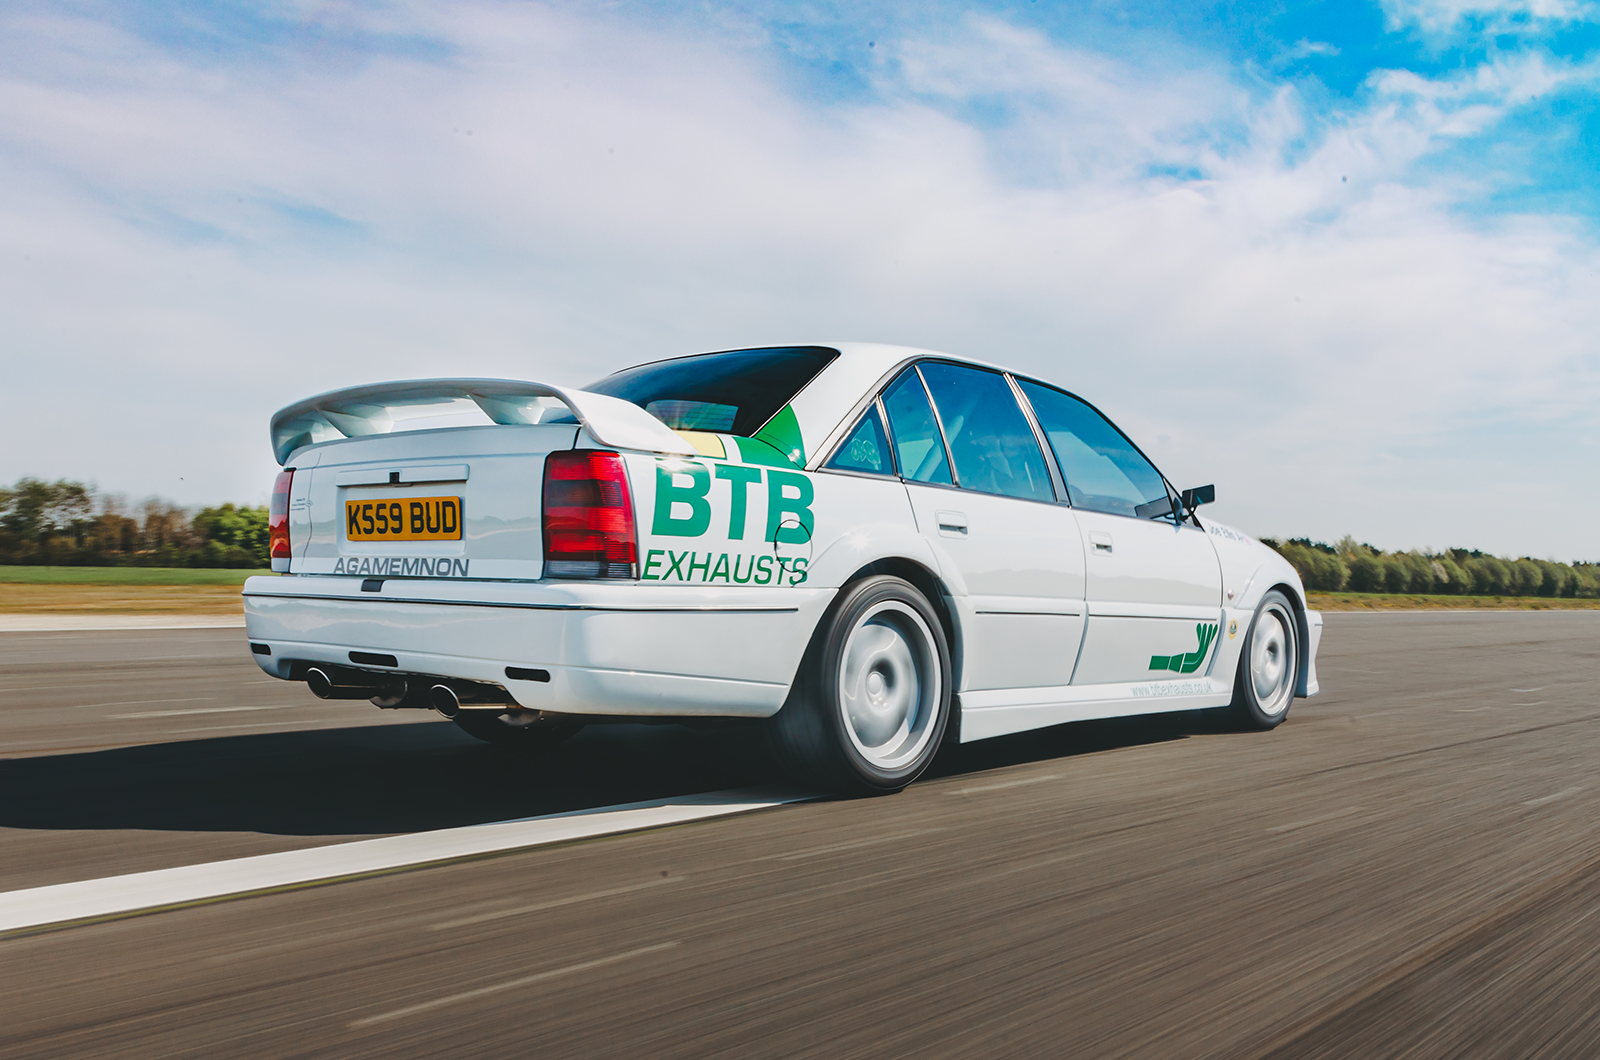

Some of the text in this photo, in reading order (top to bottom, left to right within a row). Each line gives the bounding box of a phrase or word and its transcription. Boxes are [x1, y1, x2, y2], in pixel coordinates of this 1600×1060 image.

[348, 501, 457, 535] K559 BUD
[651, 458, 814, 545] BTB
[333, 557, 470, 577] AGAMEMNON
[642, 549, 808, 586] EXHAUSTS
